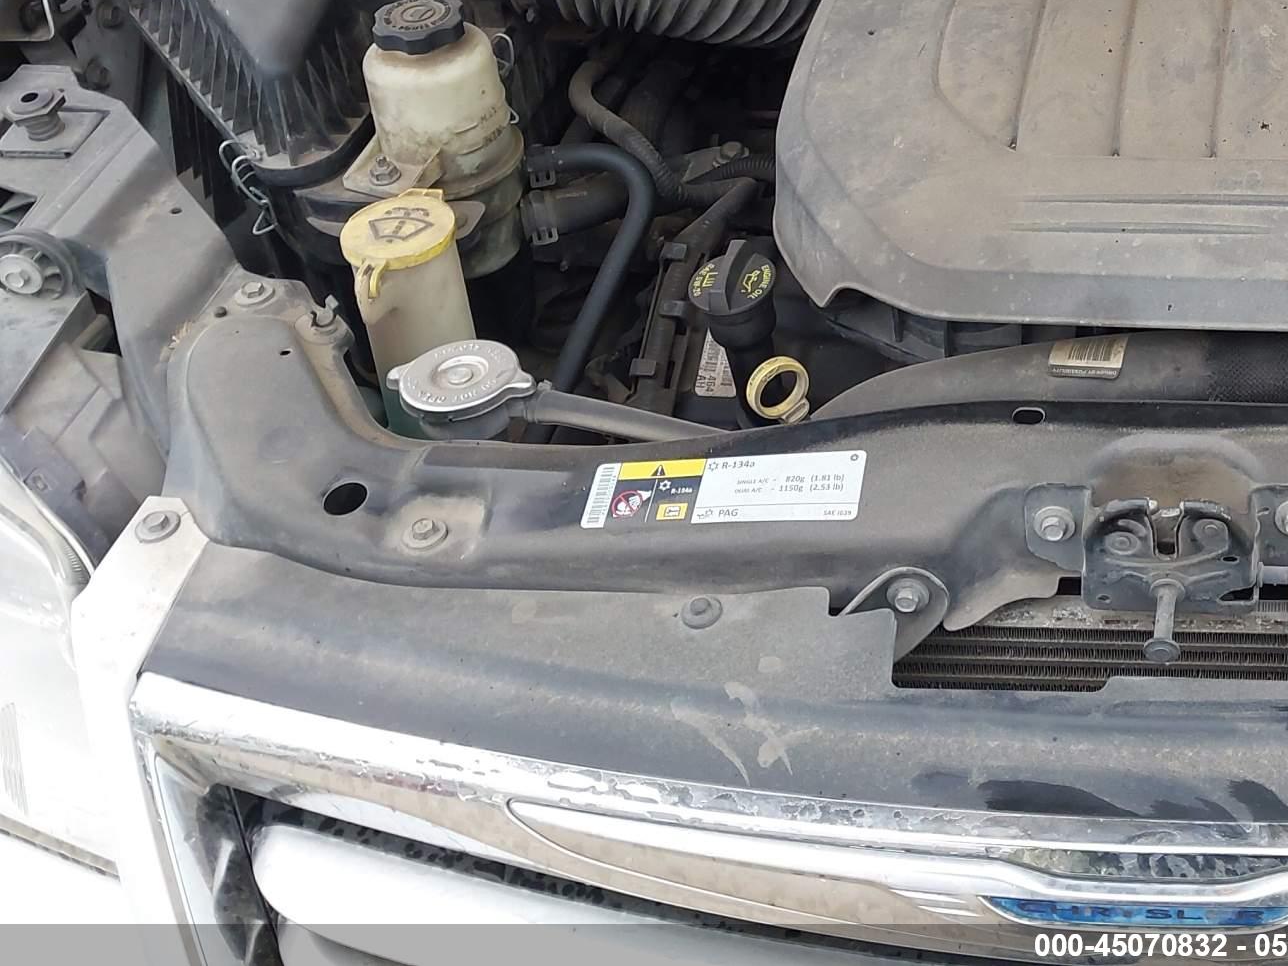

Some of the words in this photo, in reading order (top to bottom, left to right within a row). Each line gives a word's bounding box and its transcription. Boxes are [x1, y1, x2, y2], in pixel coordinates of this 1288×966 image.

[760, 264, 772, 289] ENGINE
[747, 289, 762, 300] OIL
[721, 461, 756, 470] R-134a
[785, 475, 806, 483] 820g
[810, 474, 831, 483] (1.81
[833, 474, 845, 482] lb)
[778, 484, 804, 493] 1150g
[832, 483, 844, 492] lb)
[718, 509, 739, 518] PAG
